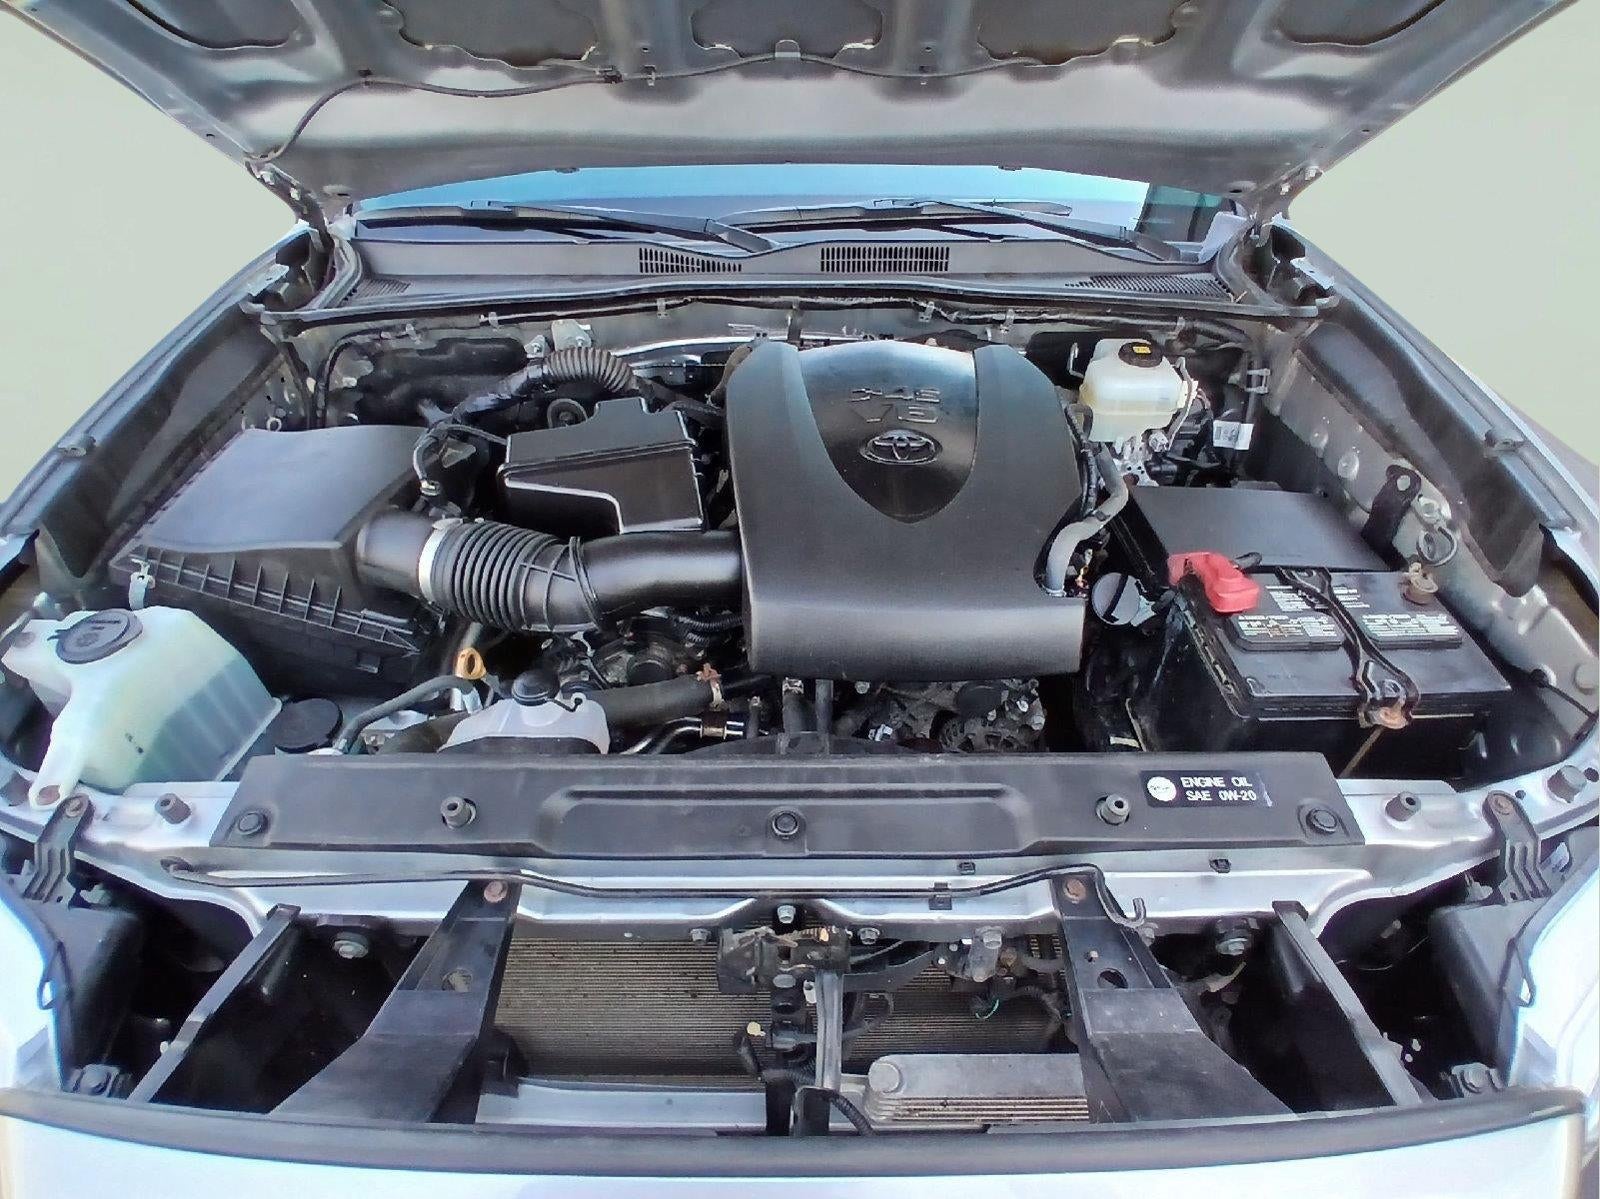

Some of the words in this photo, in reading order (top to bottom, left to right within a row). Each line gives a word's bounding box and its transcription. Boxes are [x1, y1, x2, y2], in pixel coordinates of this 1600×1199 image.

[1180, 776, 1226, 788] ENGINE
[1231, 776, 1253, 788] OIL
[1186, 790, 1213, 801] SAE
[1219, 789, 1257, 801] 0W-20
